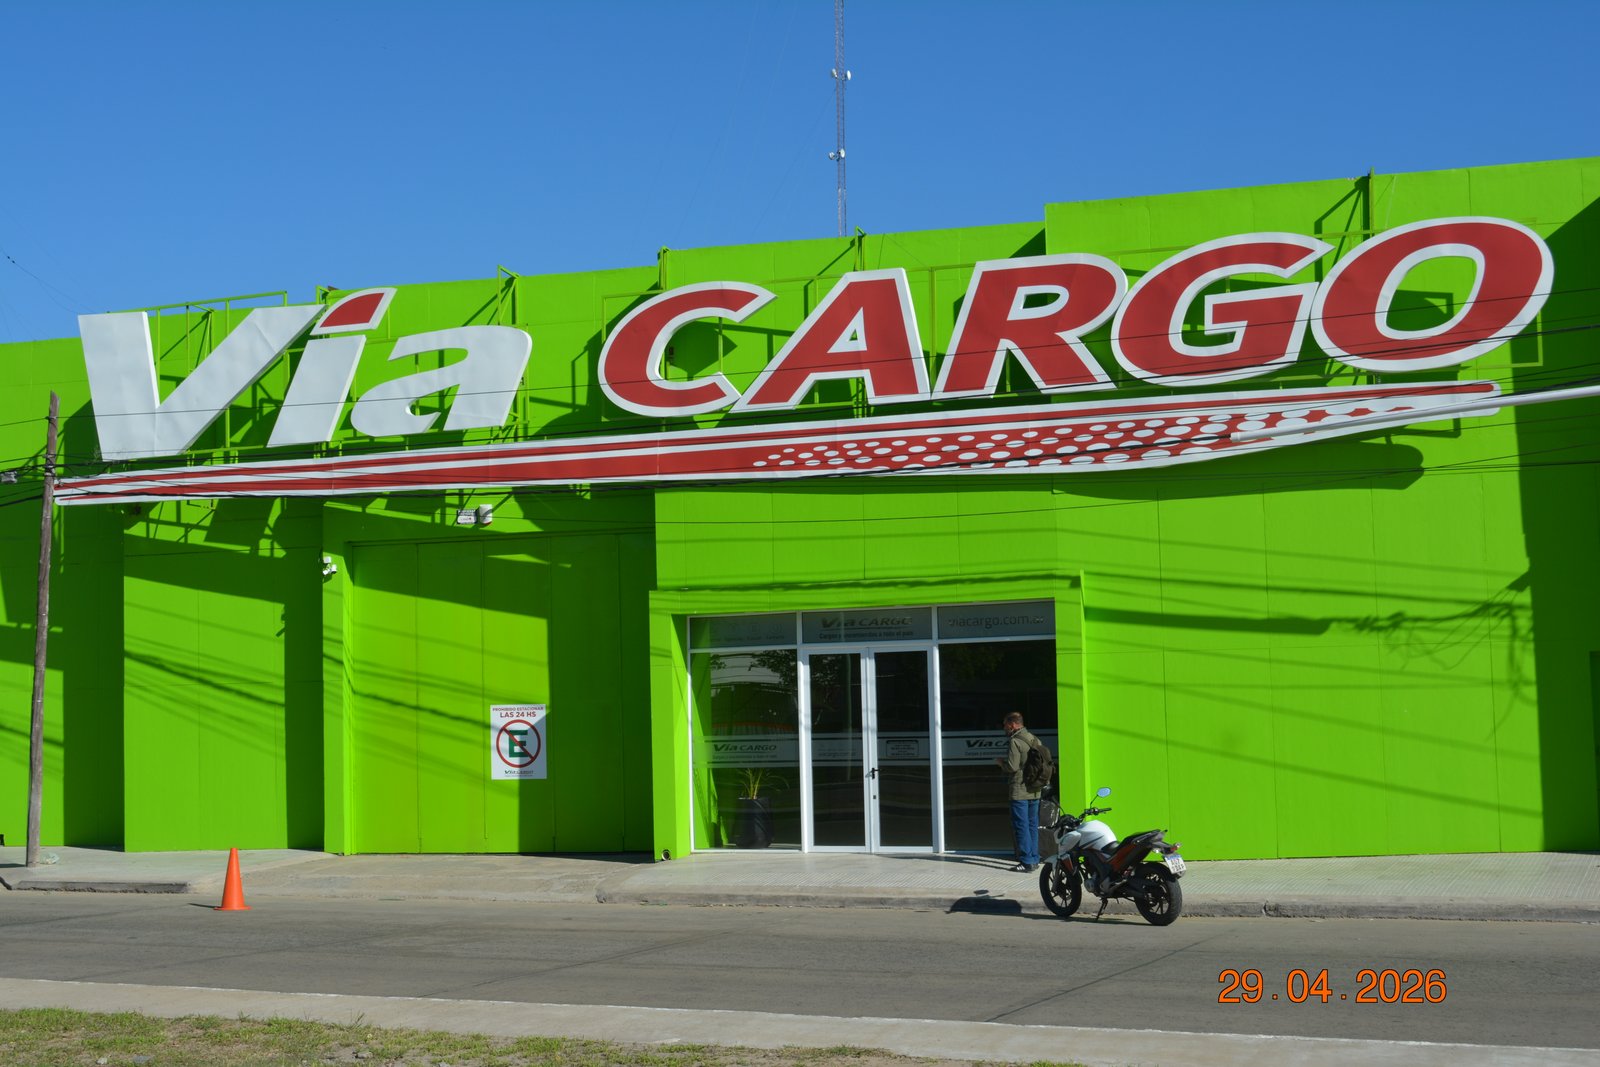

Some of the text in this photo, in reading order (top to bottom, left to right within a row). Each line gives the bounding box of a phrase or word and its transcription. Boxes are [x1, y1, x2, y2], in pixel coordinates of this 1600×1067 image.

[77, 216, 1556, 461] Via CARGO
[509, 730, 529, 758] E
[713, 744, 738, 752] Via
[965, 739, 994, 748] Via
